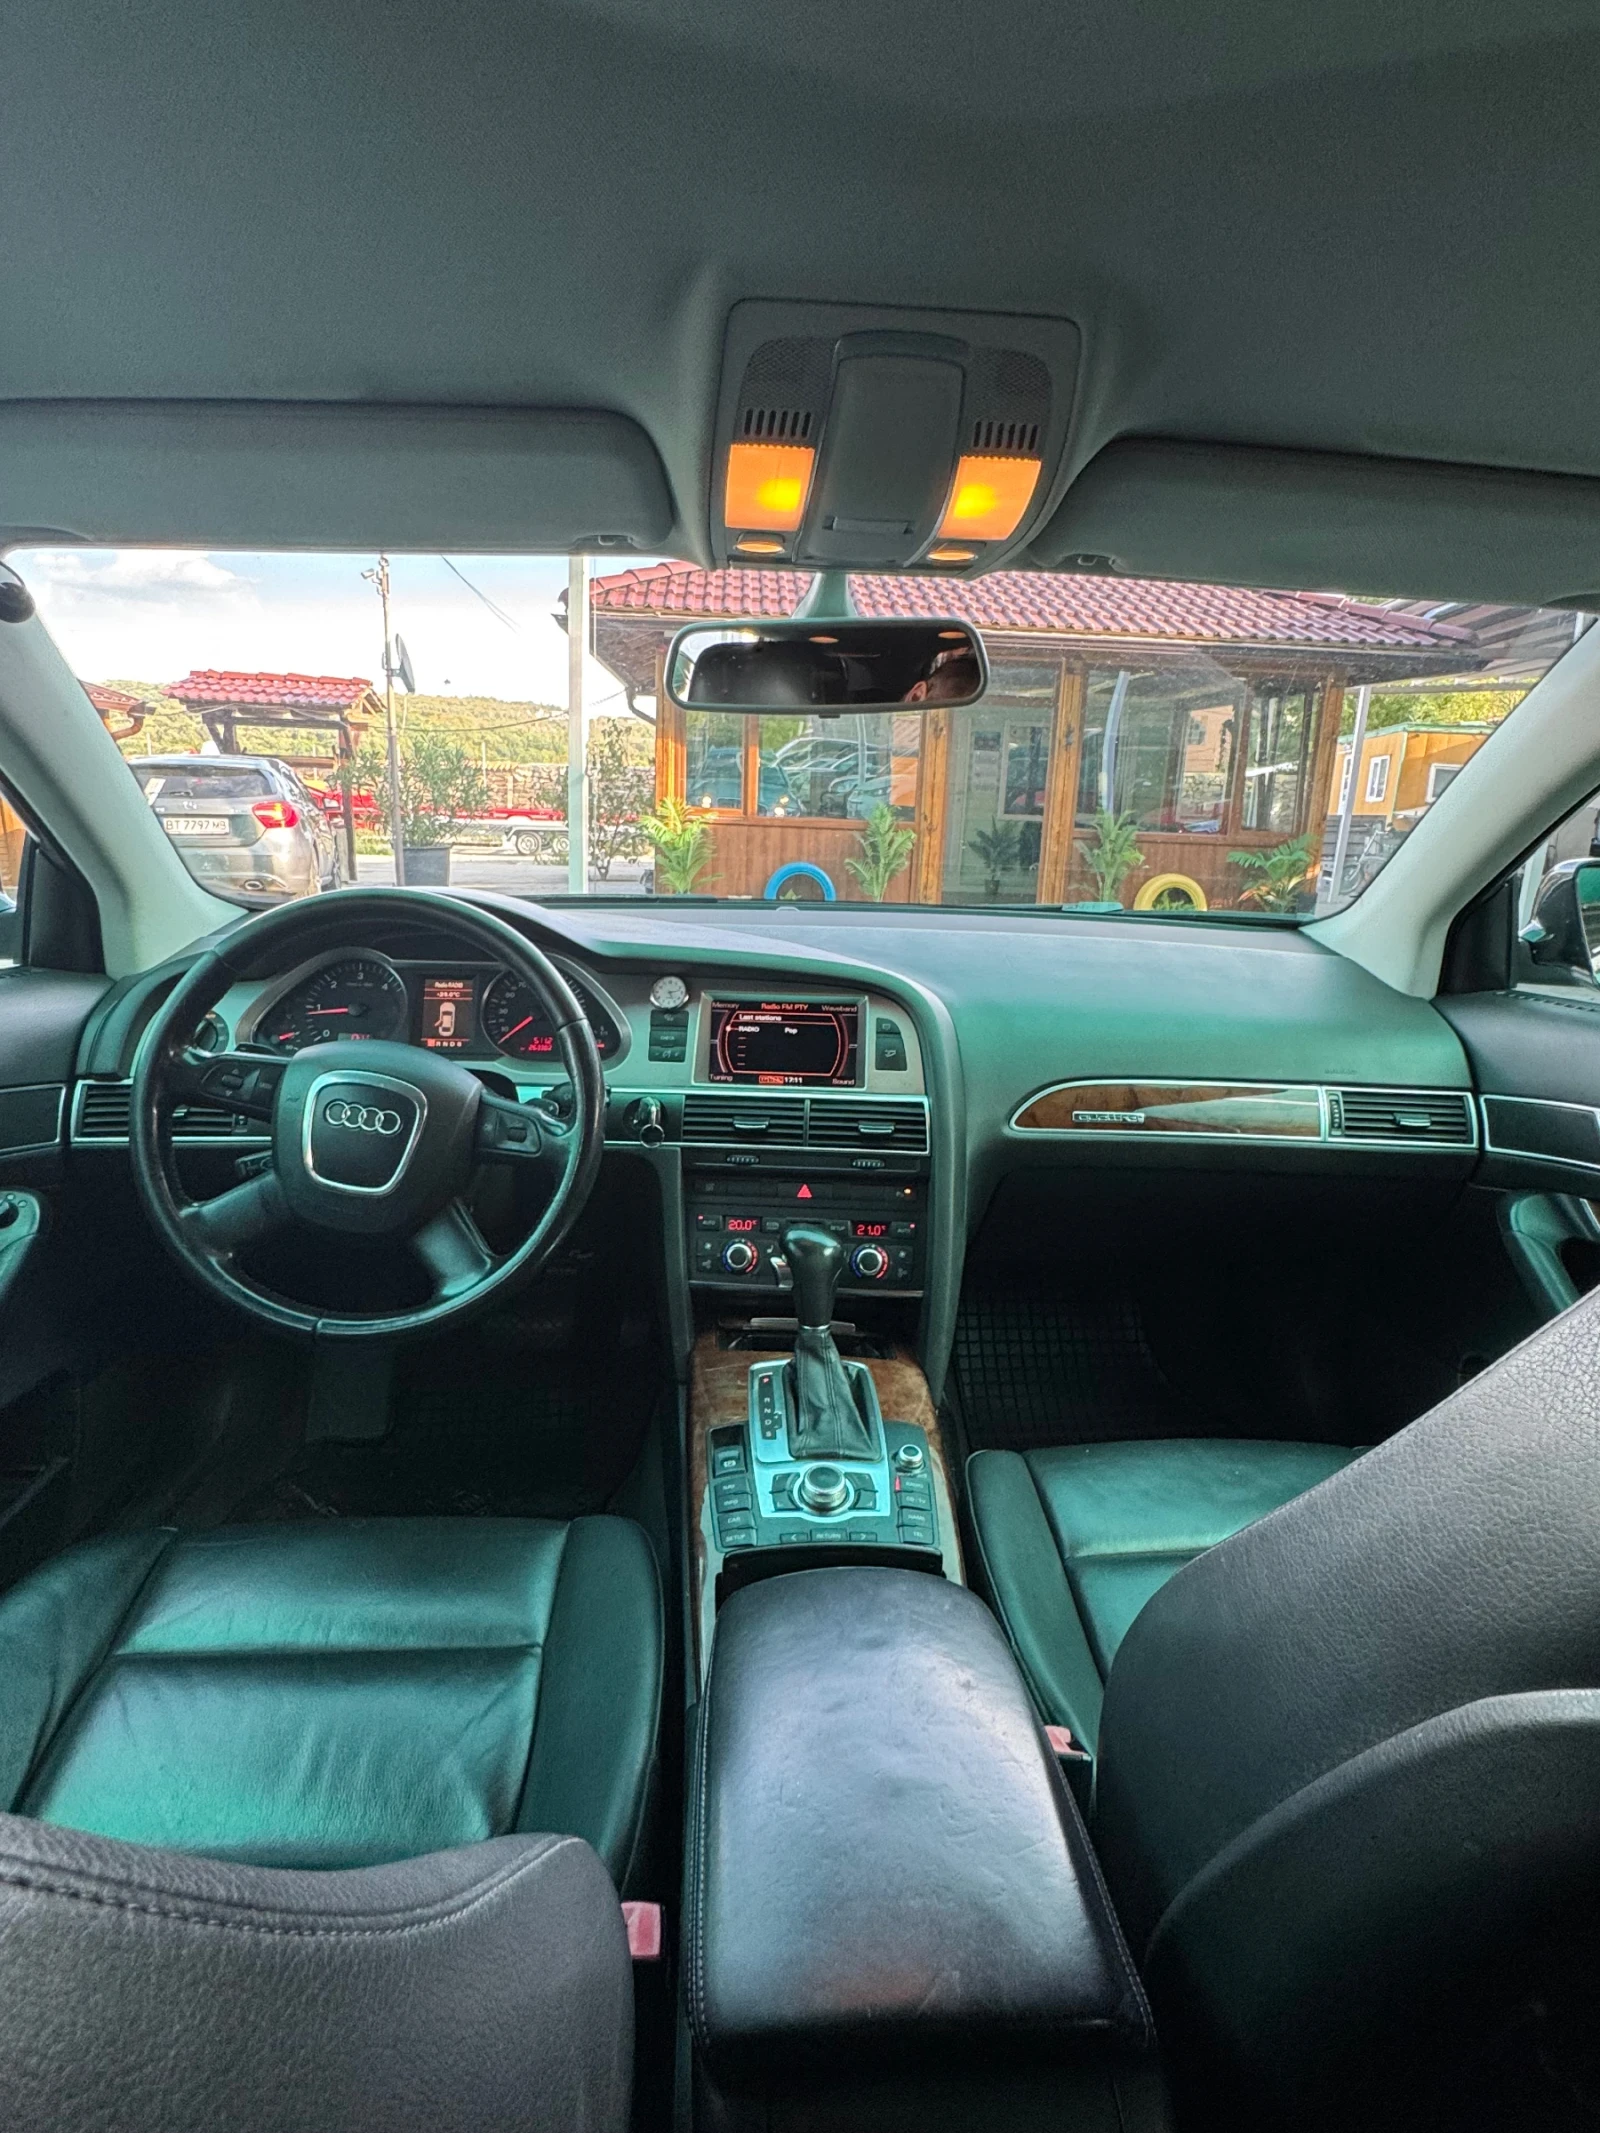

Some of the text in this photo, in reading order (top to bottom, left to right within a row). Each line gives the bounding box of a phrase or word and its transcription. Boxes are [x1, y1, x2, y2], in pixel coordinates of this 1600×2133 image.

[166, 820, 181, 831] BT
[183, 820, 210, 831] 7797
[357, 972, 364, 980] 3
[330, 981, 338, 989] 2
[712, 1002, 740, 1010] Memory
[322, 1029, 331, 1038] 0
[784, 1027, 798, 1035] Pop
[710, 1074, 733, 1082] Tuning
[784, 1076, 803, 1084] 17:11
[725, 1534, 746, 1542] SETUP
